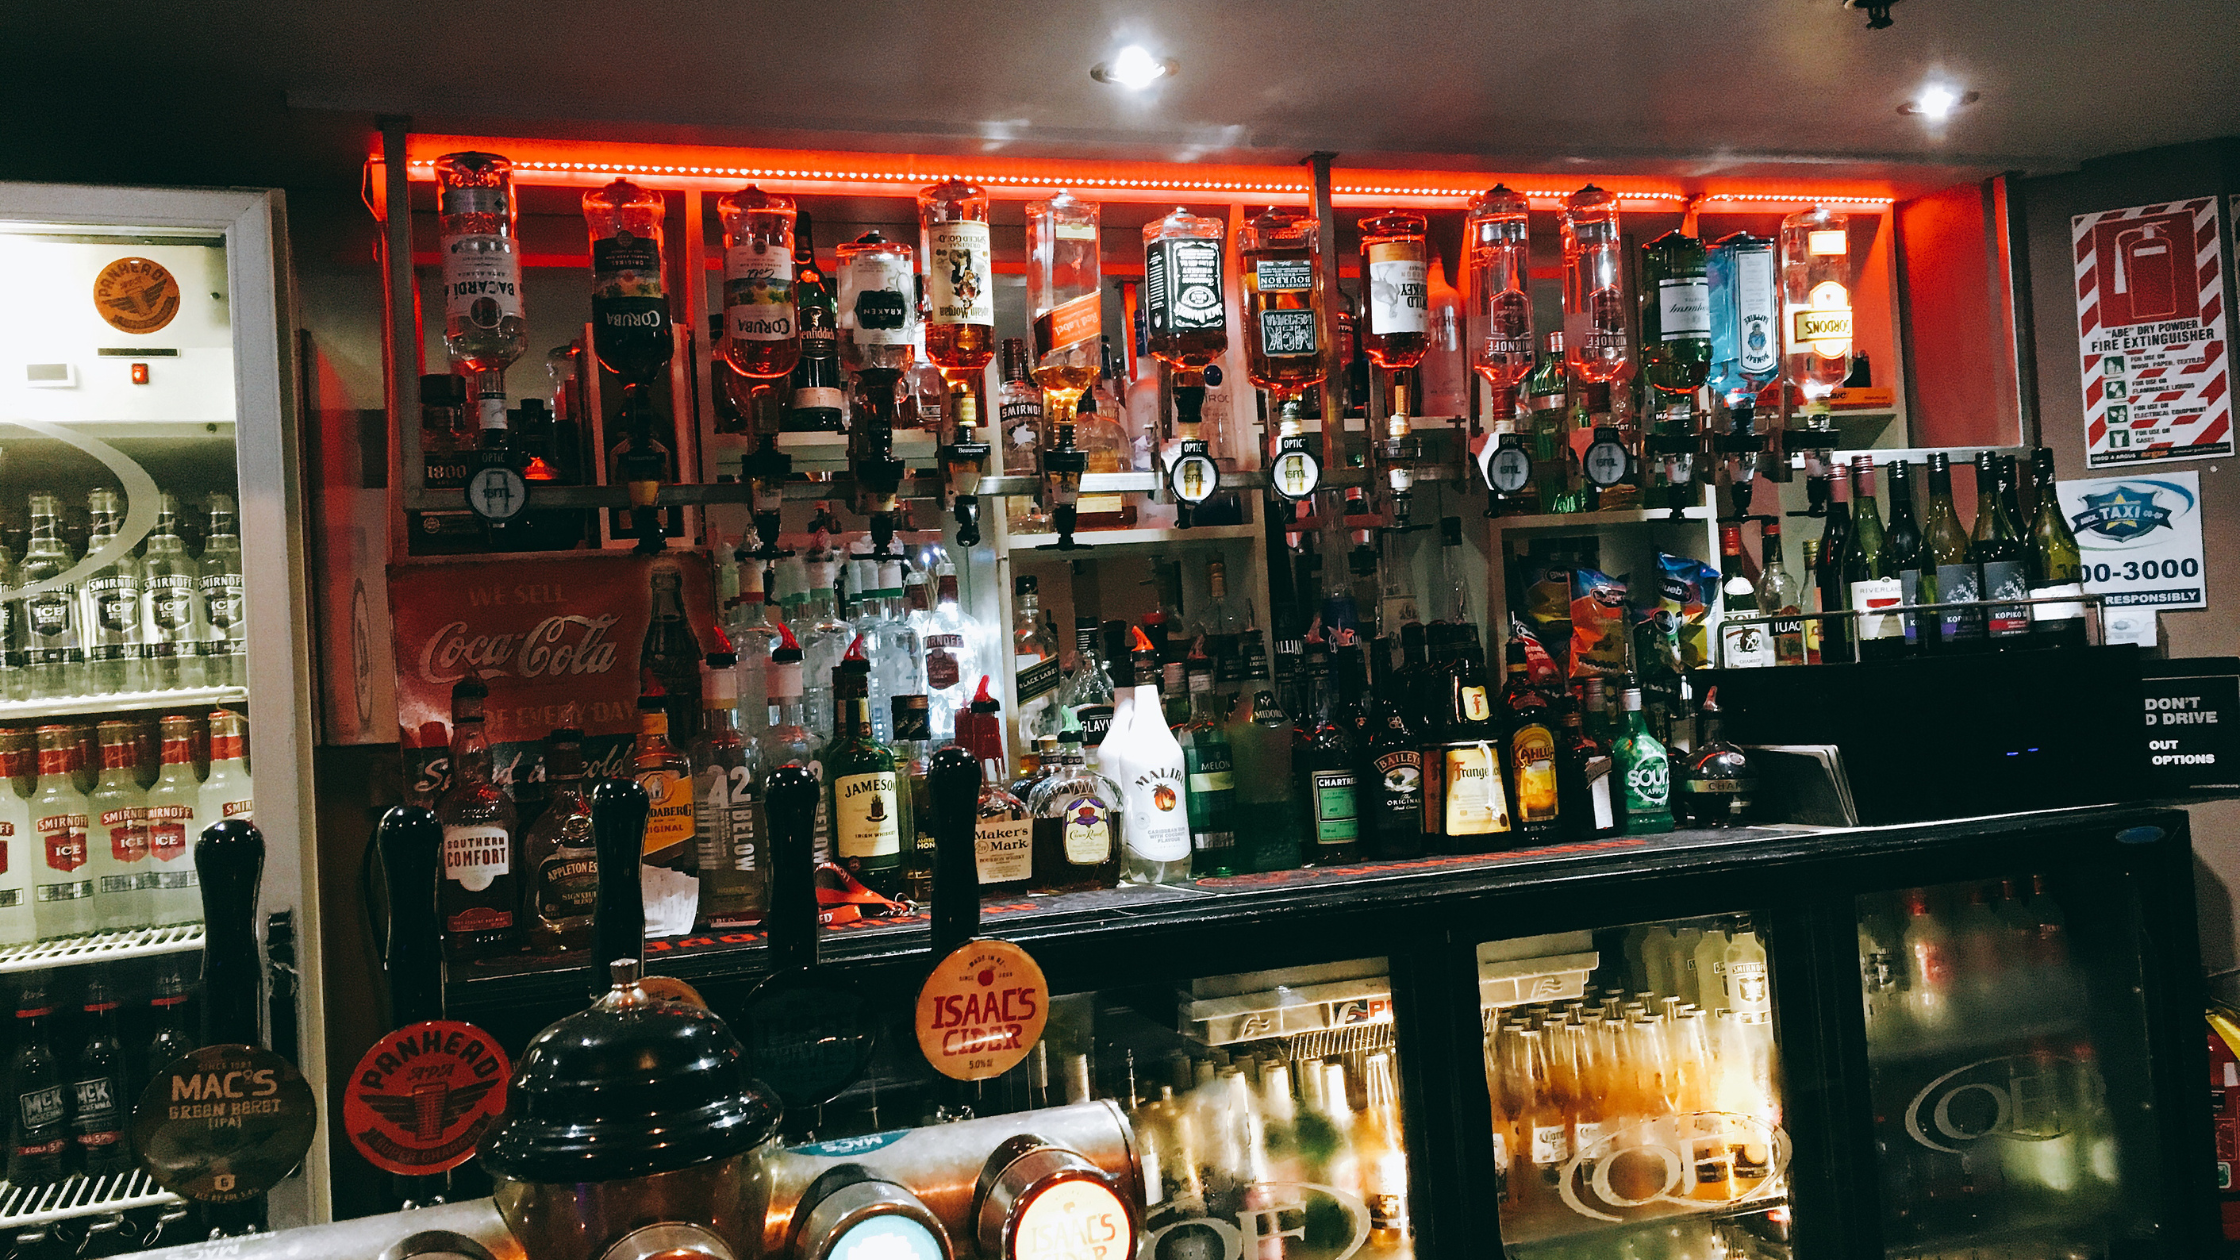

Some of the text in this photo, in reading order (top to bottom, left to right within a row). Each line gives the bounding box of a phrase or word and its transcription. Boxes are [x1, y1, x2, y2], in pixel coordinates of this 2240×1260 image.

[963, 235, 986, 244] SPICED
[99, 262, 164, 298] PANHEAD
[1260, 276, 1311, 284] BOURBON
[606, 309, 661, 328] CORUBA
[939, 306, 969, 319] Morgan
[1743, 313, 1770, 326] SAPPHIRE
[737, 317, 790, 334] CORUBA
[1053, 312, 1099, 336] Red Label
[2137, 325, 2156, 336] DRY
[2158, 320, 2199, 333] POWDER
[800, 327, 835, 341] enfiddich
[2091, 328, 2215, 353] FIRE EXTINGUISHER
[1745, 353, 1770, 364] BOMBAY
[1183, 442, 1203, 453] OPTIC
[1283, 437, 1304, 449] OPTIC
[426, 464, 468, 479] 1800
[2099, 505, 2141, 520] TAXI
[89, 577, 139, 593] SMIRNOFF
[2105, 591, 2197, 605] RESPONSIBLY
[36, 606, 64, 618] ICE
[1994, 611, 2022, 619] KOPIKO
[418, 611, 624, 685] Coca-Cola
[1018, 677, 1040, 689] BLACK
[2145, 696, 2201, 711] DON'T
[2162, 711, 2218, 725] DRIVE
[2149, 740, 2179, 750] OUT
[1200, 761, 1231, 771] MELON
[1379, 752, 1421, 769] BAILEYS
[2152, 754, 2216, 765] OPTIONS
[706, 765, 752, 809] 42
[1646, 787, 1666, 795] APPLE
[39, 816, 89, 832] SMIRNOFF
[154, 835, 179, 846] ICE
[732, 809, 756, 872] BELOW
[974, 827, 1029, 841] Maker's
[120, 837, 145, 848] ICE
[446, 836, 505, 850] SOUTHERN
[990, 839, 1029, 851] Mark
[55, 844, 81, 856] ICE
[446, 847, 506, 868] COMFORT
[547, 861, 589, 882] APPLETON
[931, 987, 1036, 1030] ISAAC'S
[941, 1023, 1024, 1057] CIDER
[360, 1030, 500, 1090] PANHEAD
[171, 1069, 278, 1101] MAC'S
[169, 1099, 281, 1120] GREEN BERET
